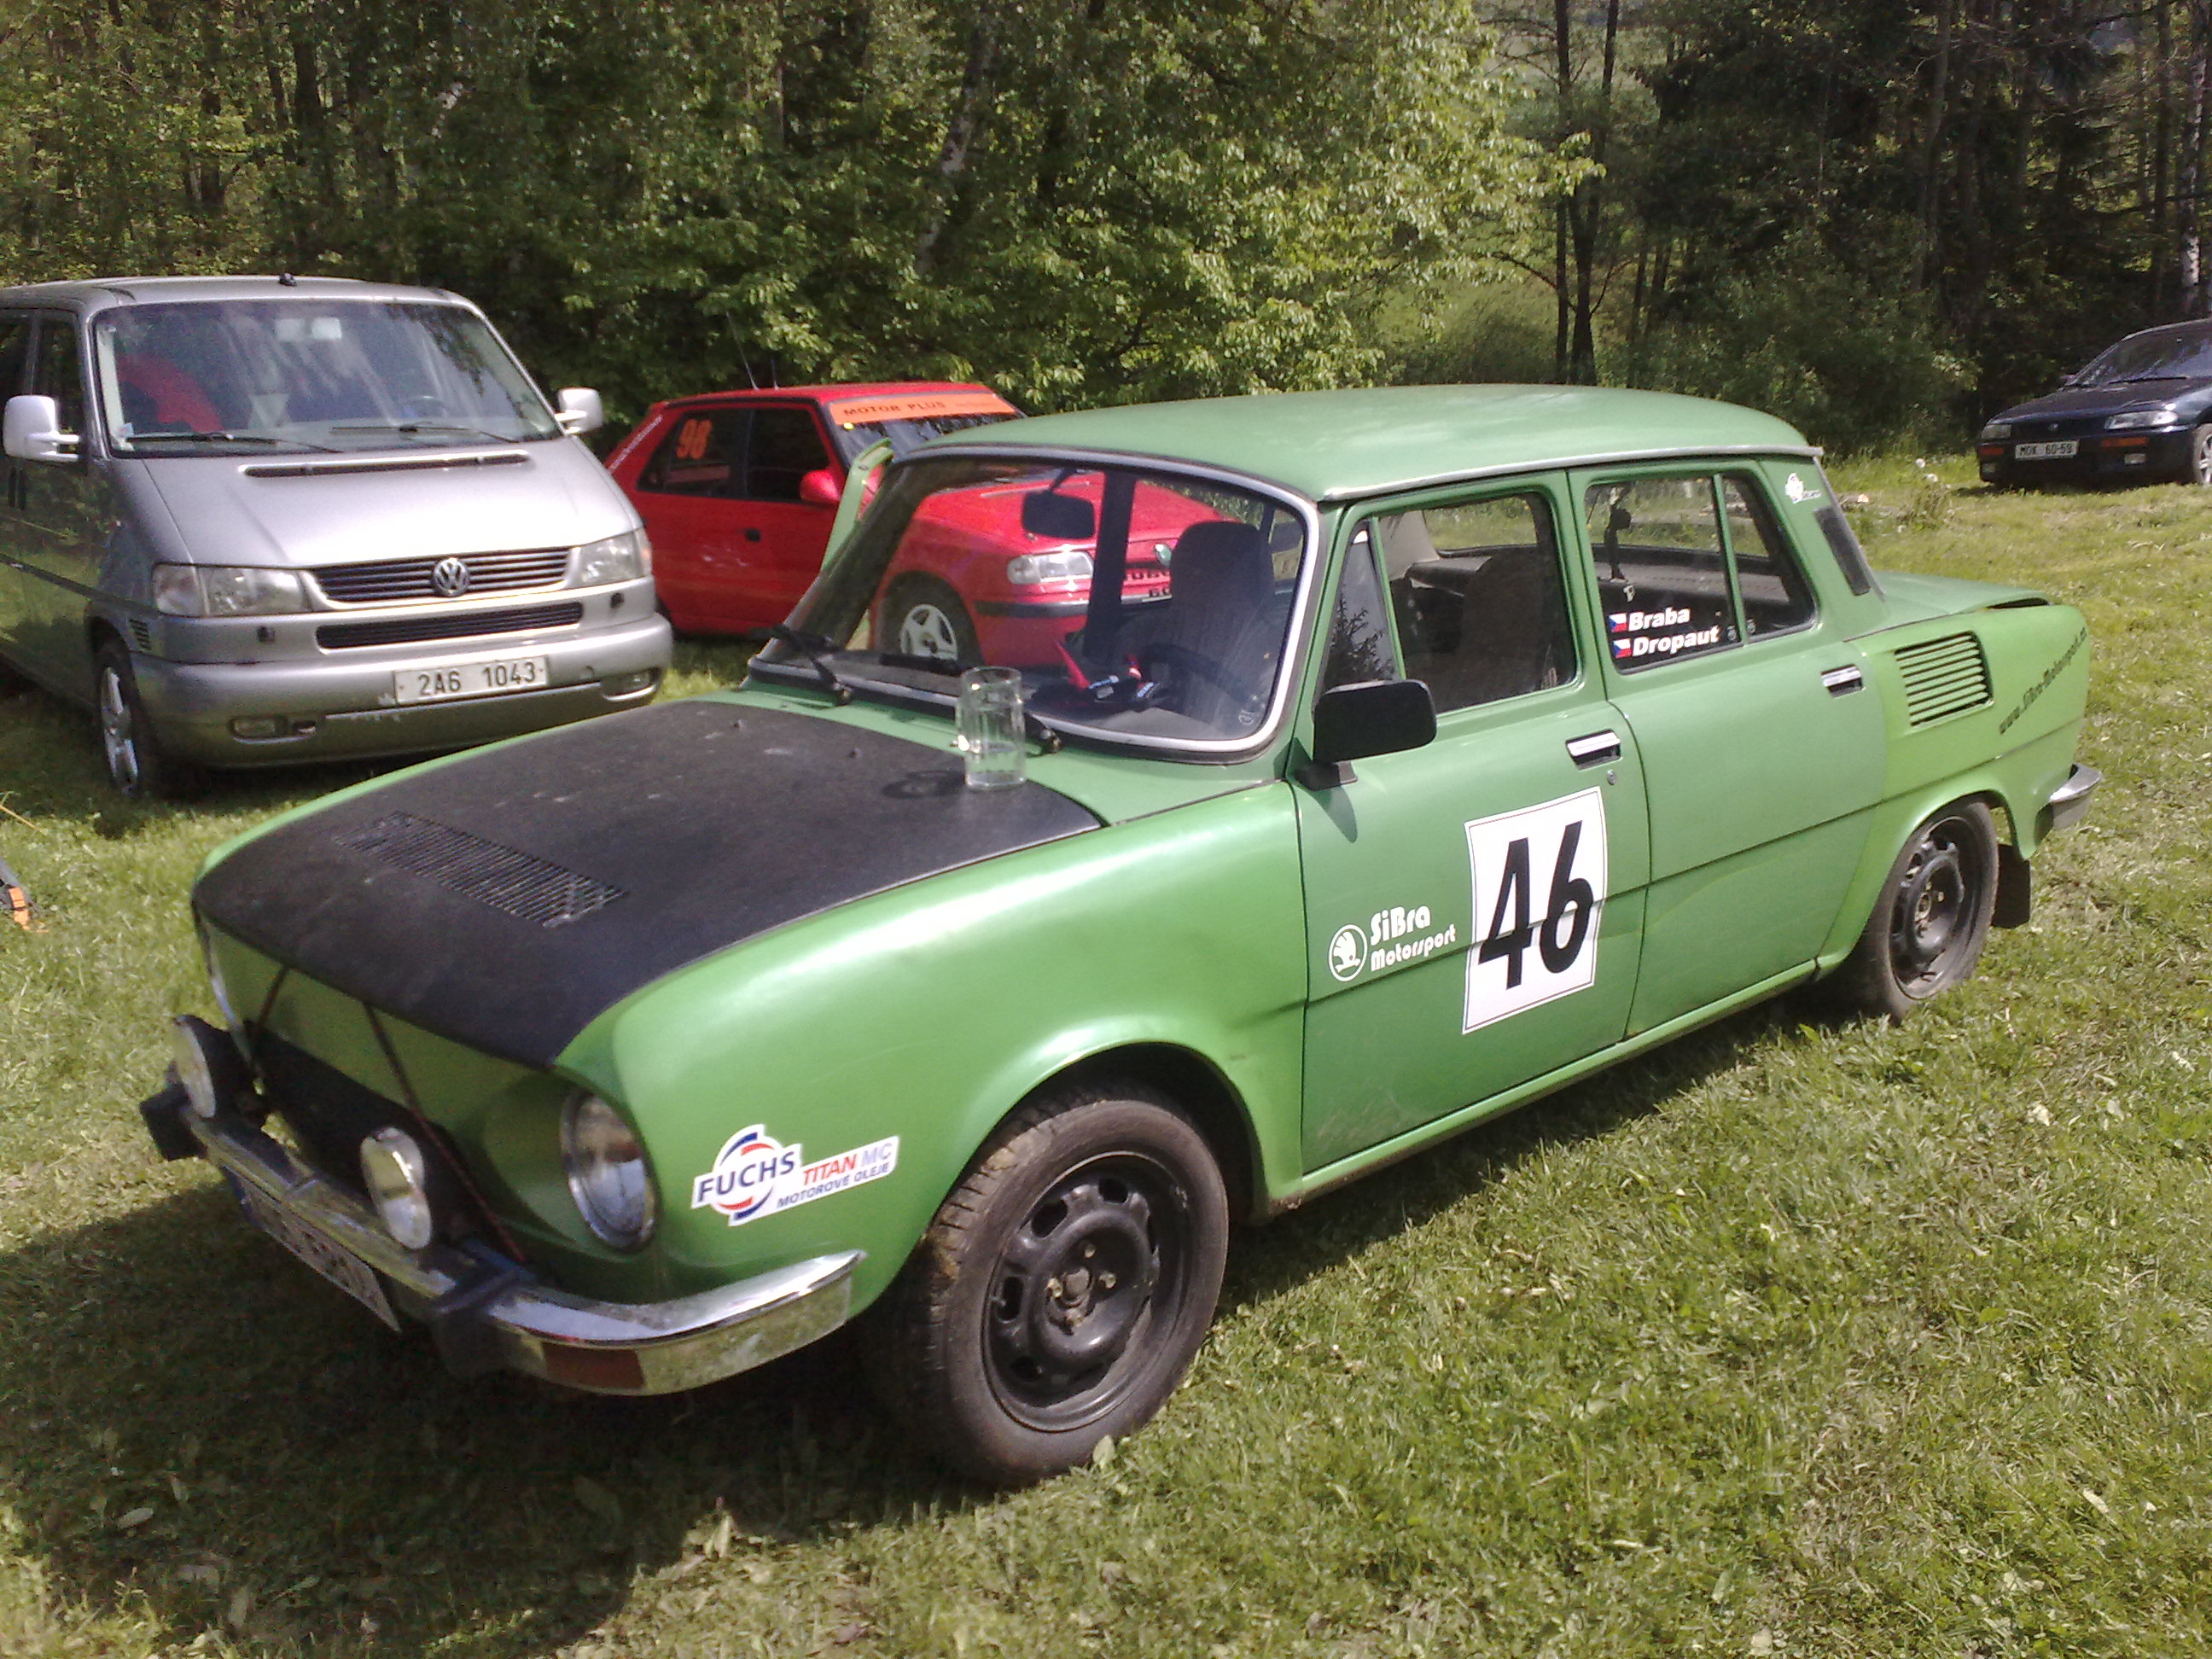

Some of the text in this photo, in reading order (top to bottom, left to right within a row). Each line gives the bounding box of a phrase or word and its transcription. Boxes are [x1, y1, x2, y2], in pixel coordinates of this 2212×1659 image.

[843, 405, 901, 416] MOTOR
[907, 402, 946, 410] PLUS
[1628, 607, 1691, 632] Braba
[1632, 625, 1720, 657] Dropaut
[418, 661, 535, 696] 2A6 1043
[1478, 819, 1594, 990] 46
[1371, 905, 1431, 945] SiBra
[1371, 924, 1456, 971] Motorsport
[697, 1151, 795, 1202] FUCHS
[803, 1143, 893, 1185] TITAN MC
[854, 1161, 889, 1182] OLEJE
